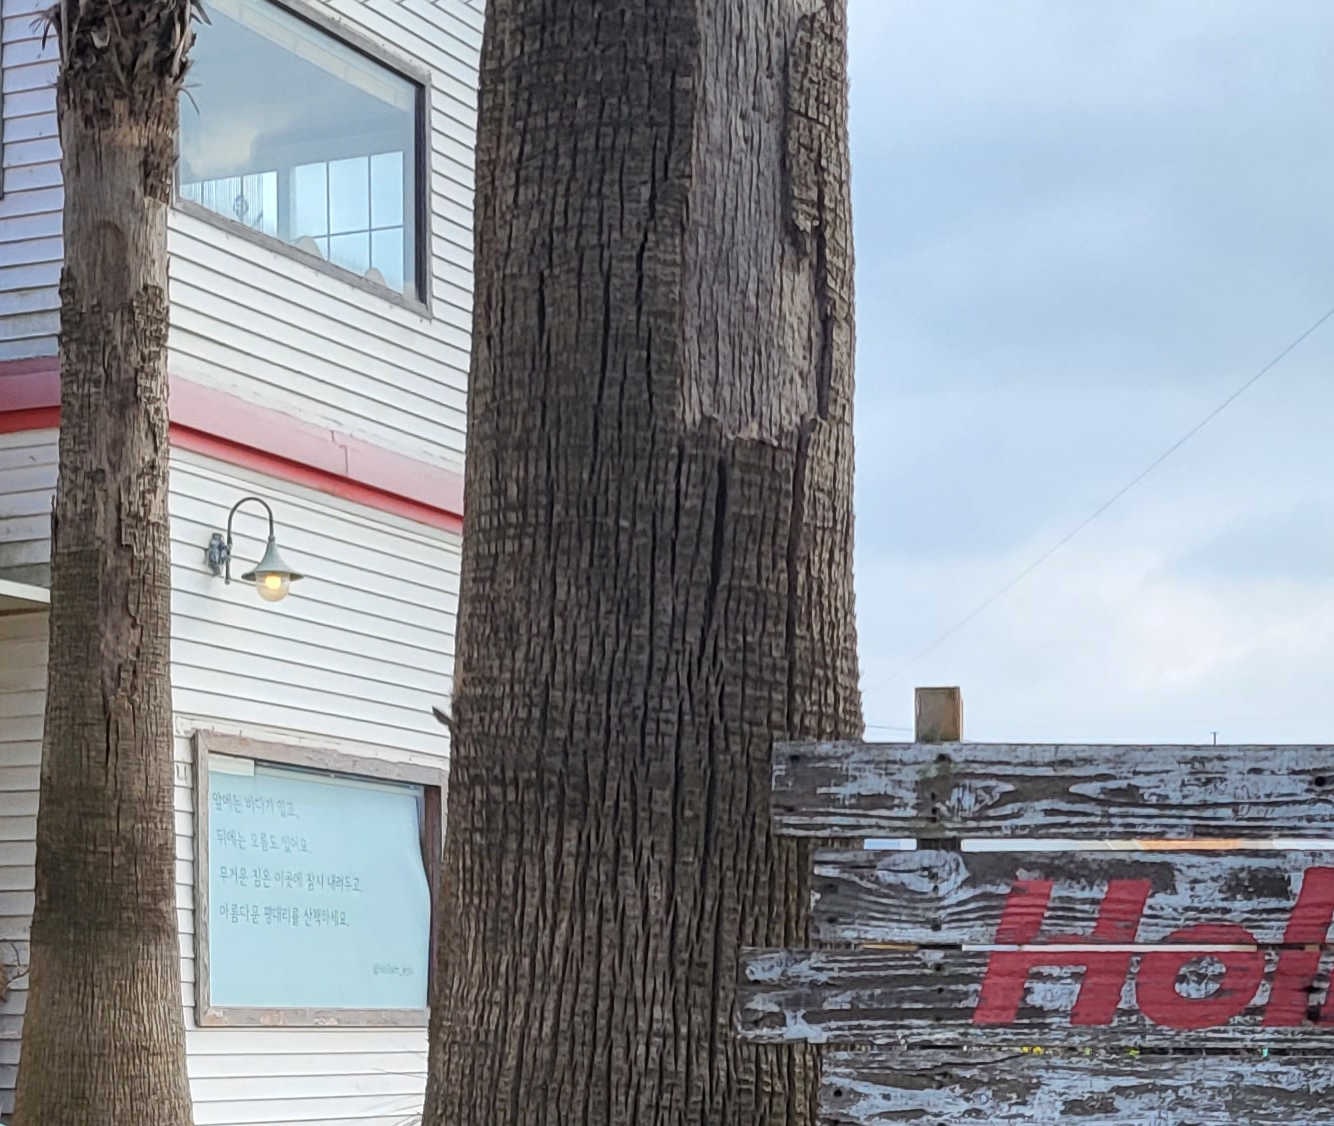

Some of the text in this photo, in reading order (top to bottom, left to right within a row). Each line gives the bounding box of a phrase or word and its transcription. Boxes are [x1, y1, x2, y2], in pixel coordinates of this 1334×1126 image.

[213, 791, 243, 813] 앞에는
[245, 795, 275, 814] 바다가
[216, 828, 246, 850] 뒤에는
[251, 832, 280, 852] 오름도
[219, 866, 249, 887] 무거운
[252, 868, 272, 889] 짐은
[274, 869, 303, 889] 이곳에
[306, 872, 324, 892] 잠시
[219, 903, 261, 924] 아름다운
[264, 905, 300, 927] 평대리를
